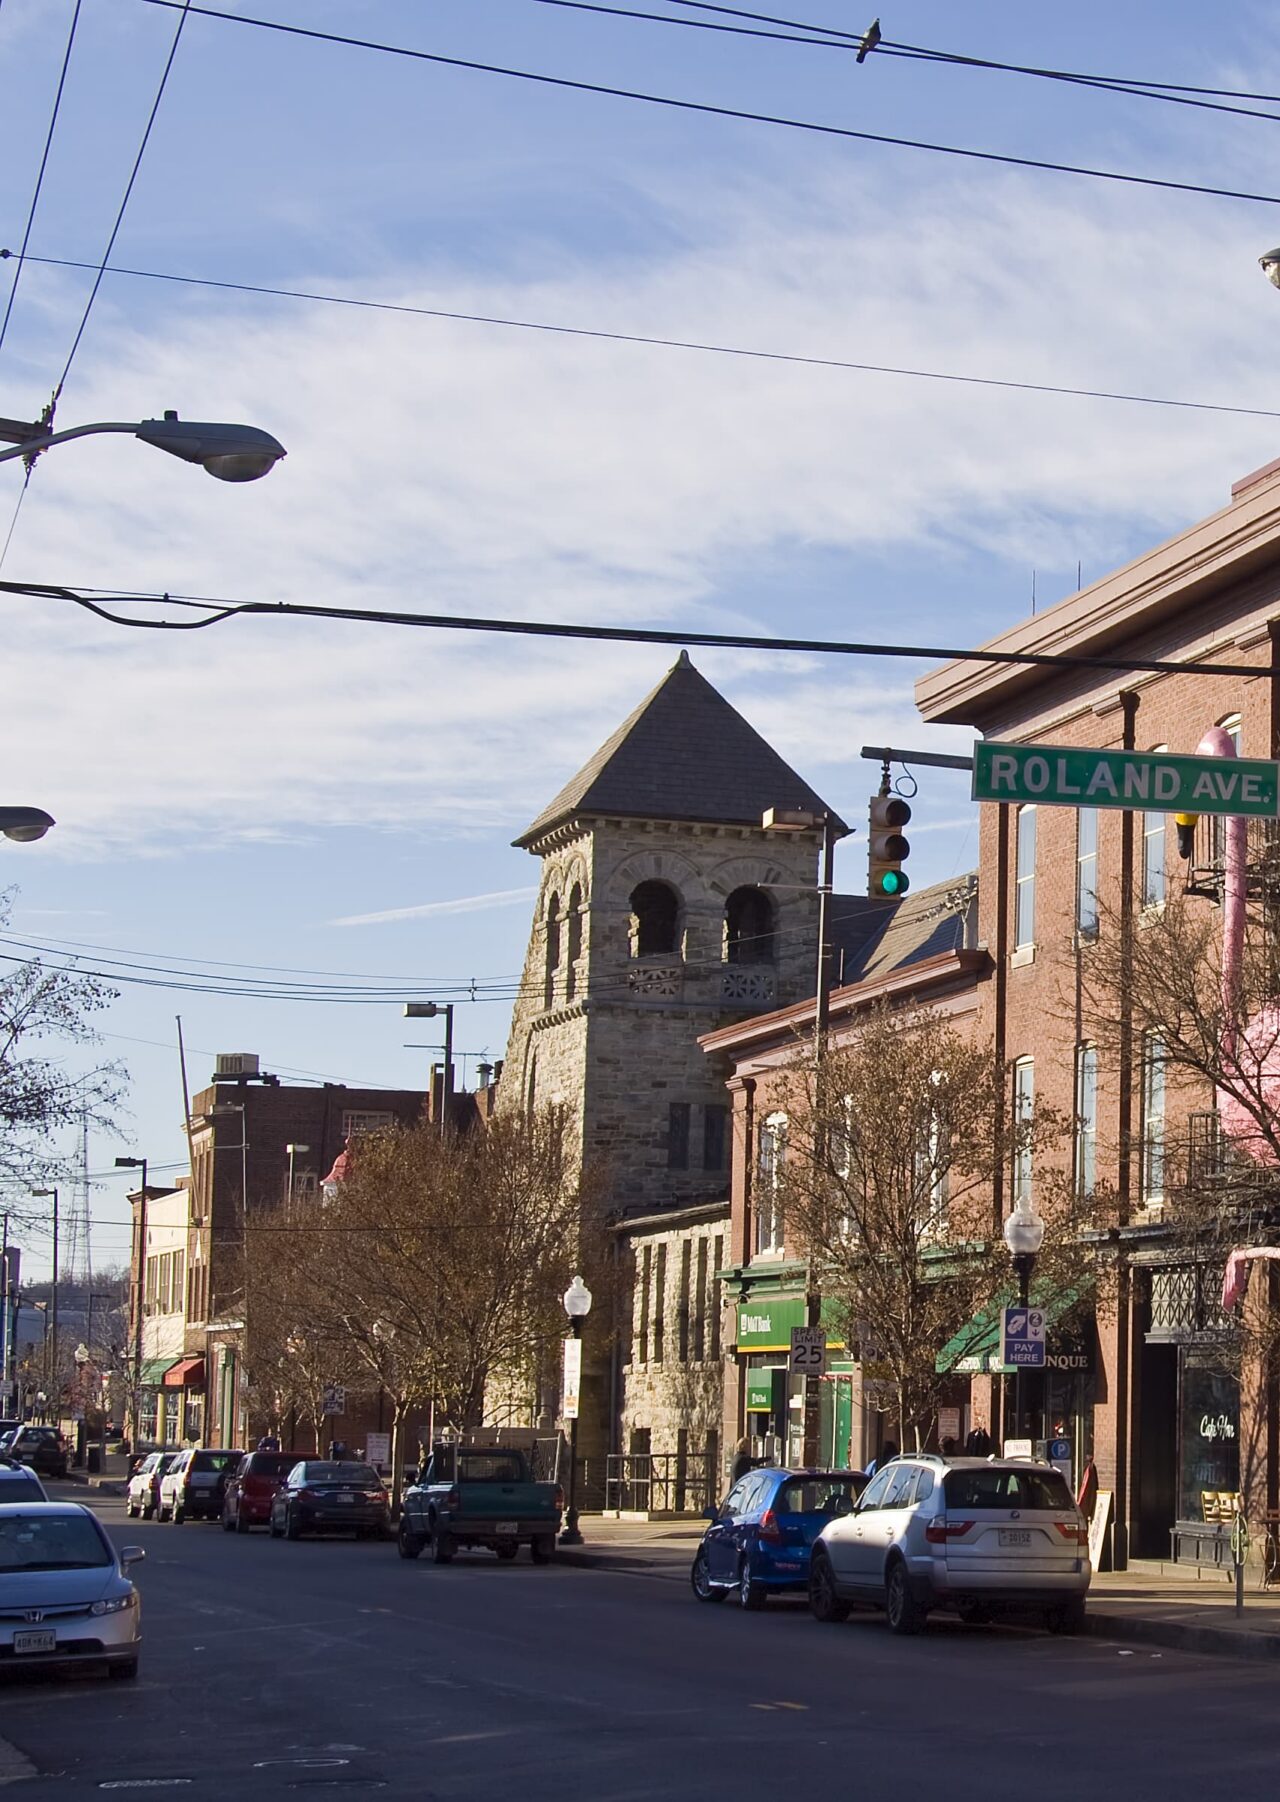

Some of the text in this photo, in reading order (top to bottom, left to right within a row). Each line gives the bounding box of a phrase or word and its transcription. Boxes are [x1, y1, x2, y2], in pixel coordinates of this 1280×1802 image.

[990, 754, 1271, 804] ROLAND AVE.
[1033, 1313, 1039, 1323] 2
[794, 1335, 822, 1344] LIMIT
[1014, 1343, 1035, 1352] PAY
[794, 1345, 821, 1364] 25
[1010, 1353, 1038, 1363] HERE
[1200, 1415, 1235, 1442] Cafe Hon
[1057, 1443, 1066, 1456] P
